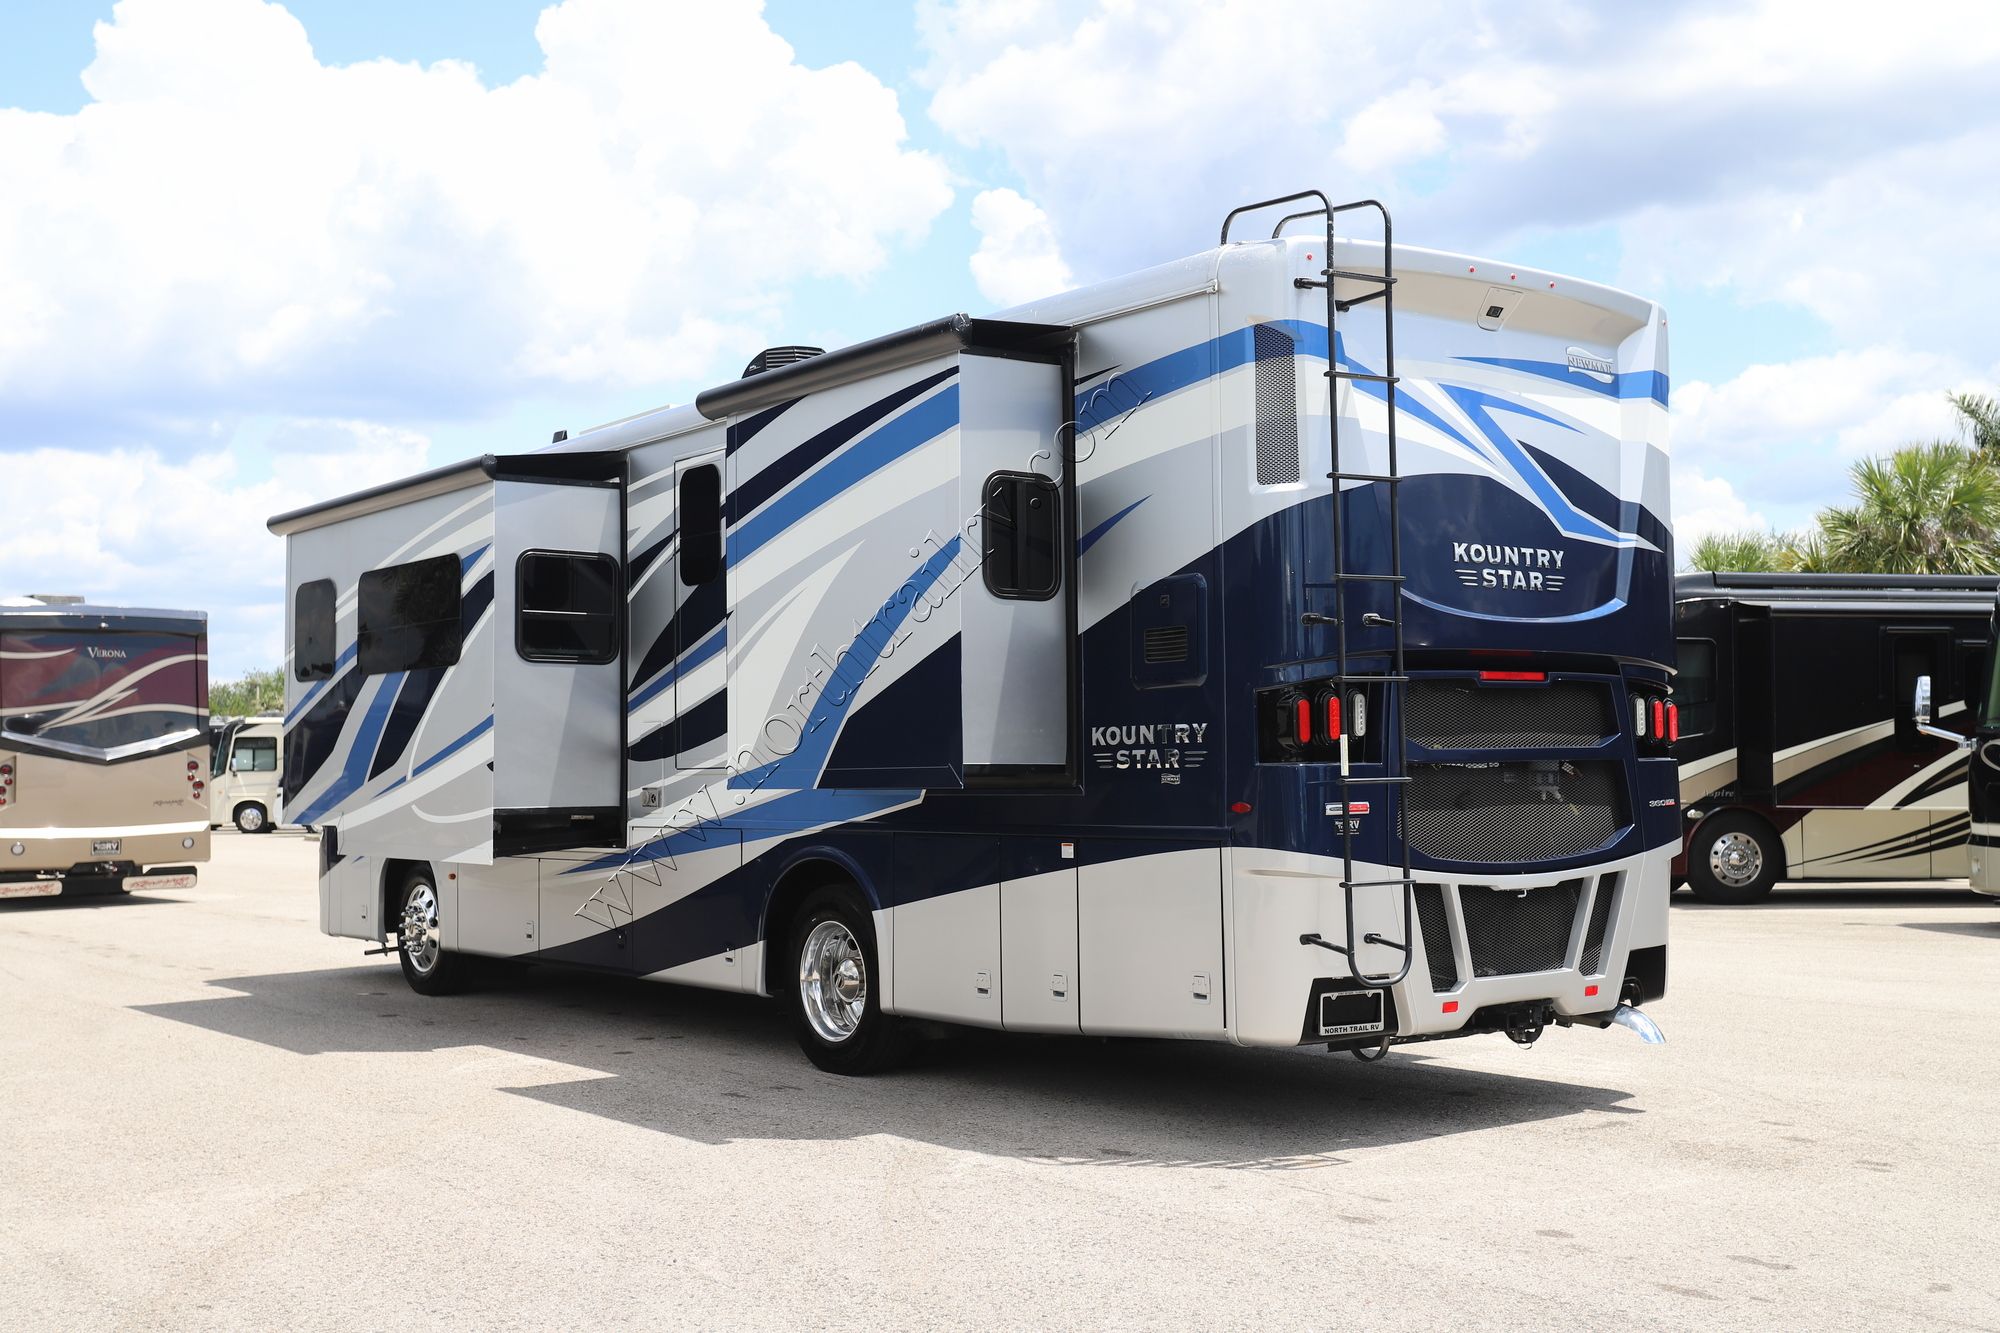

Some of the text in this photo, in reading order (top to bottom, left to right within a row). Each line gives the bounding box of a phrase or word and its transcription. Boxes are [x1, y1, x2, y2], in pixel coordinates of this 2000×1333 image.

[1452, 541, 1565, 569] KOUNTRY
[1481, 568, 1544, 591] STAR
[1091, 722, 1208, 746] KOUNTRY
[1116, 748, 1180, 769] STAR
[1324, 1023, 1380, 1035] NORTH TRAIL RV
